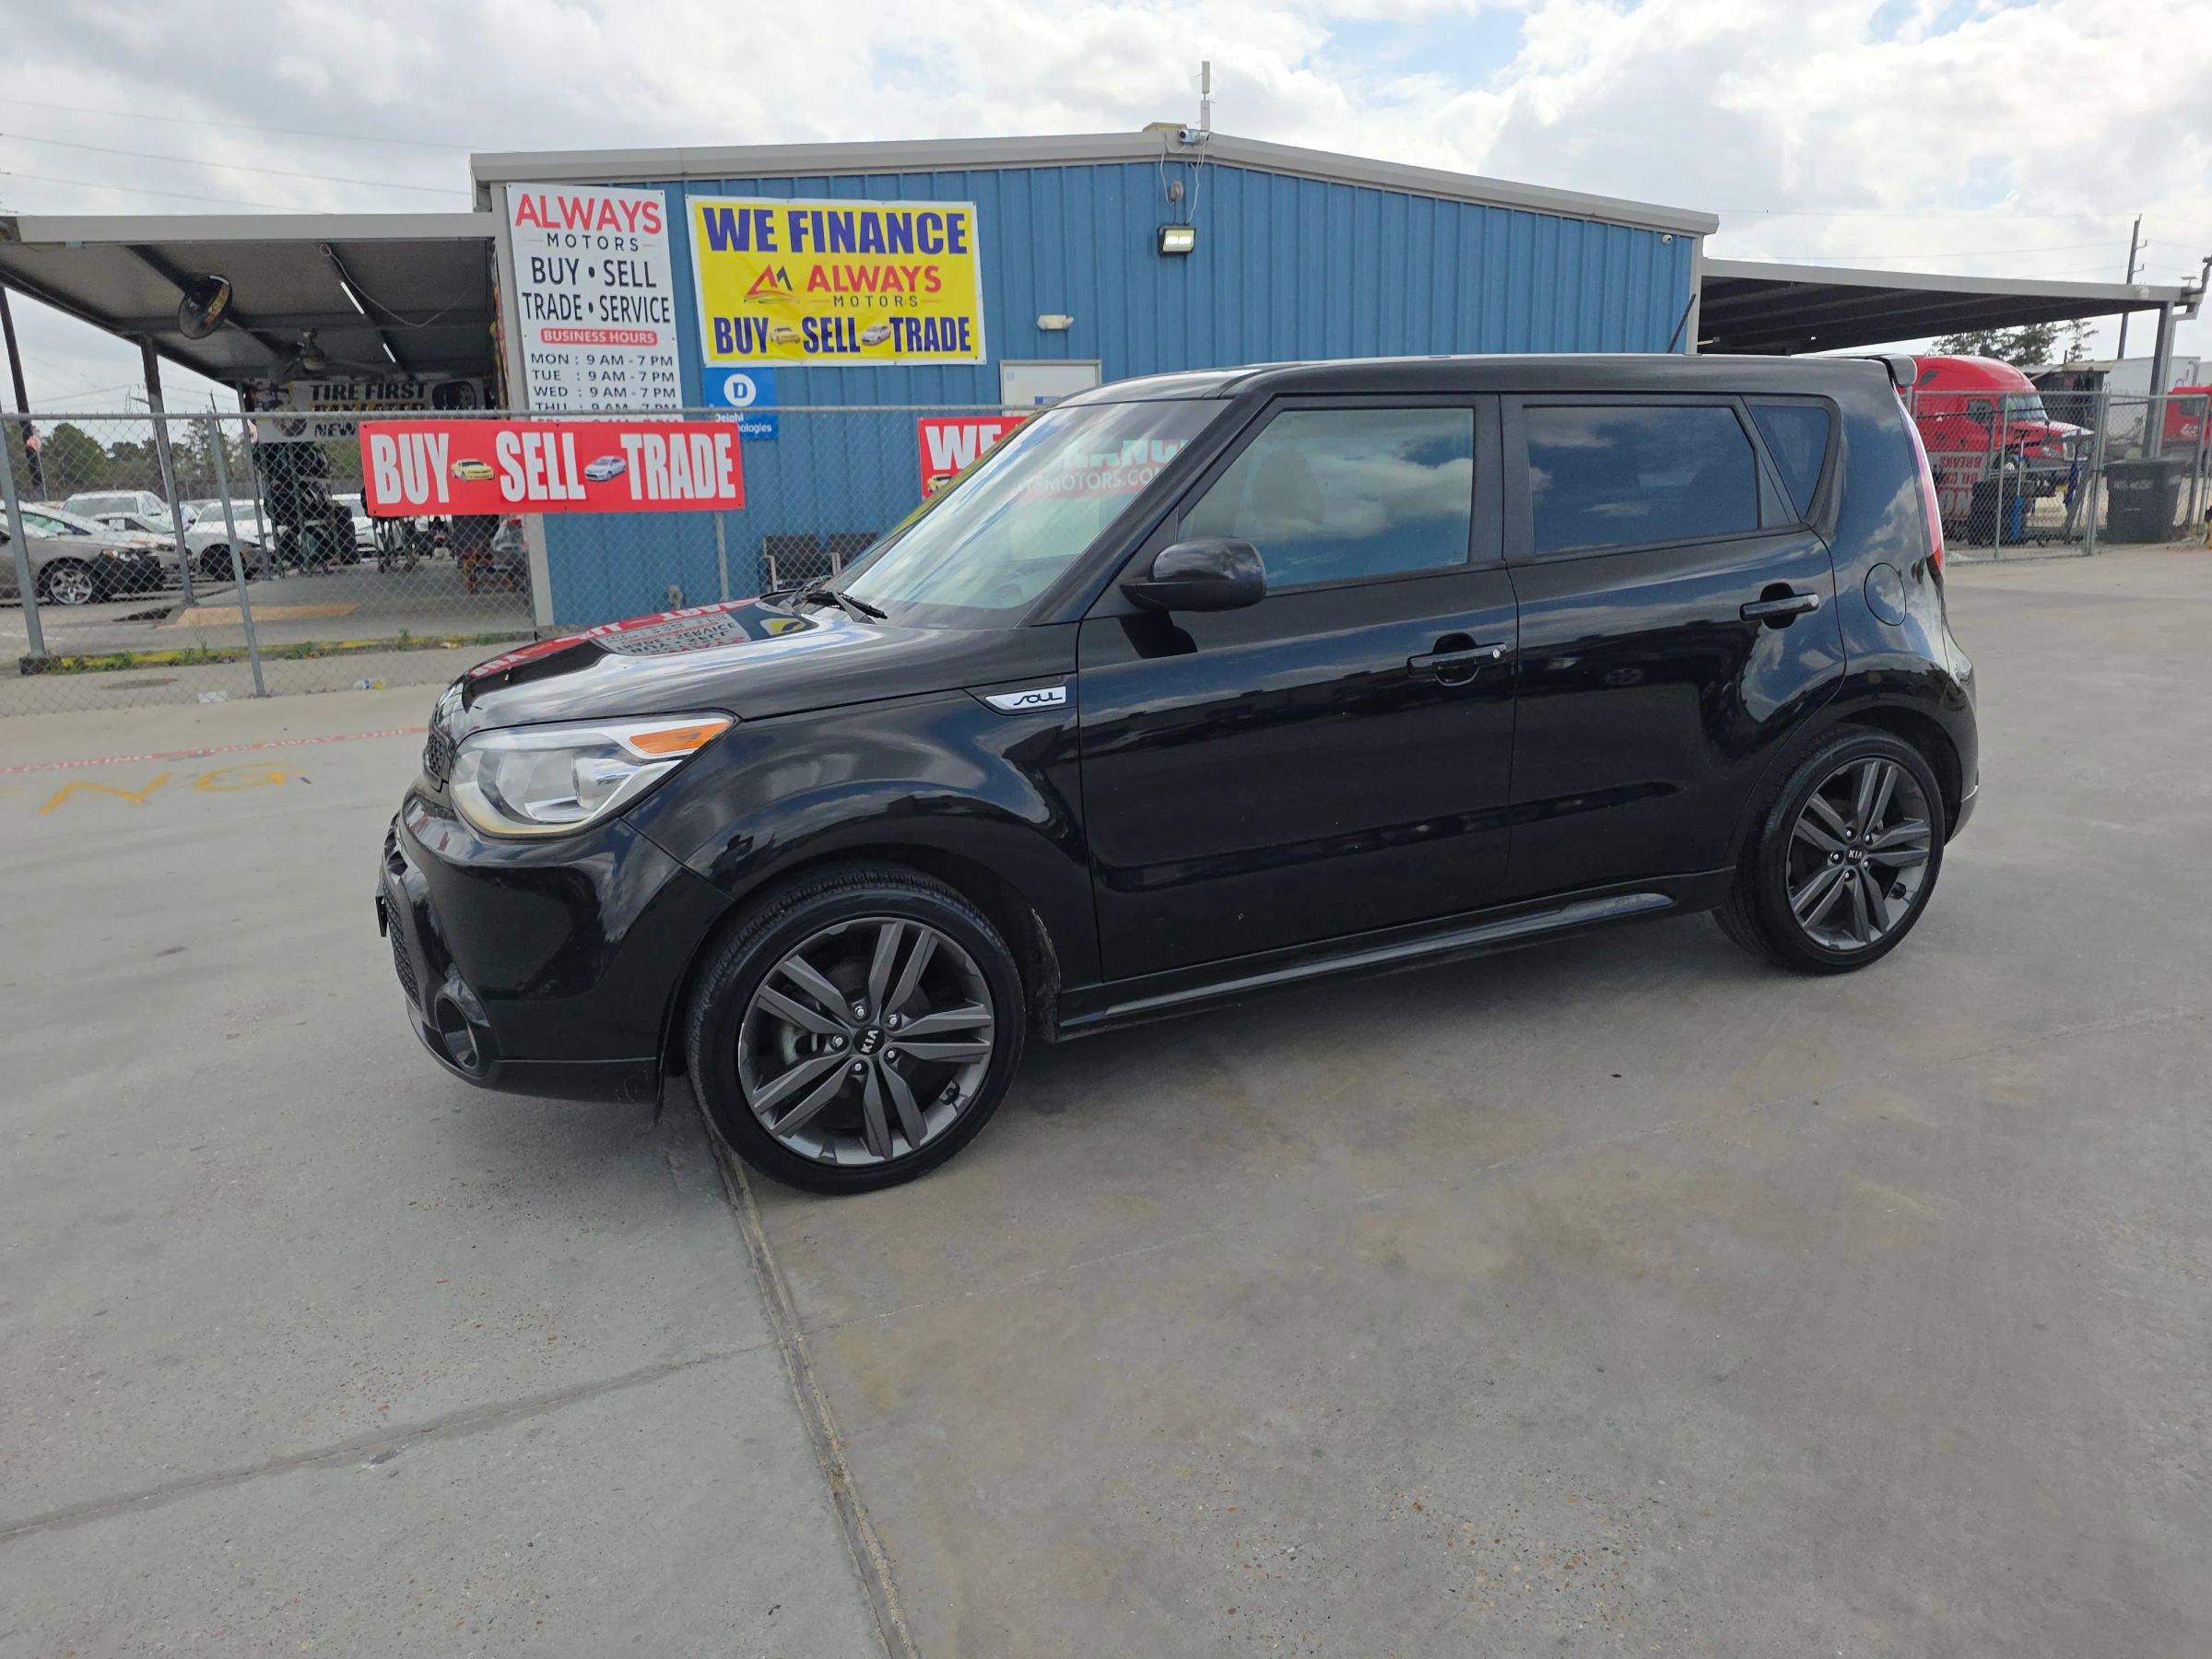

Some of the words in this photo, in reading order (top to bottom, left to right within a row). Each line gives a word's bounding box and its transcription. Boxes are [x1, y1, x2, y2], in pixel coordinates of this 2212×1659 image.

[515, 194, 662, 235] ALWAYS
[702, 207, 777, 253] WE
[787, 210, 968, 255] FINANCE
[547, 232, 639, 252] MOTORS
[531, 256, 579, 285] BUY
[604, 259, 656, 288] SELL
[806, 265, 942, 292] ALWAYS
[522, 292, 582, 321] TRADE
[599, 295, 670, 324] SERVICE
[833, 295, 918, 308] MOTORS
[544, 329, 606, 343] BUSINESS
[609, 331, 654, 344] HOURS
[713, 317, 770, 354] BUY
[802, 316, 860, 353] SELL
[889, 316, 971, 352] TRADE
[531, 353, 569, 365] MON
[586, 355, 595, 365] 9
[600, 355, 624, 365] AM
[637, 356, 645, 366] 7
[651, 356, 673, 366] PM
[531, 370, 561, 381] TUE
[588, 371, 596, 382] 9
[601, 371, 626, 382] AM
[639, 371, 647, 382] 7
[652, 371, 675, 382] PM
[310, 384, 359, 401] TIRE
[365, 382, 428, 399] FIRST
[533, 386, 568, 397] WED
[590, 387, 598, 397] 9
[603, 387, 627, 398] AM
[640, 387, 648, 398] 7
[653, 387, 676, 398] PM
[314, 423, 356, 437] NEW
[738, 423, 772, 434] ologies
[370, 432, 450, 505] BUY
[496, 430, 587, 502] SELL
[620, 432, 735, 500] TRADE
[1013, 692, 1063, 706] SOUL
[1848, 849, 1863, 859] KIA
[861, 1030, 879, 1053] KIA
